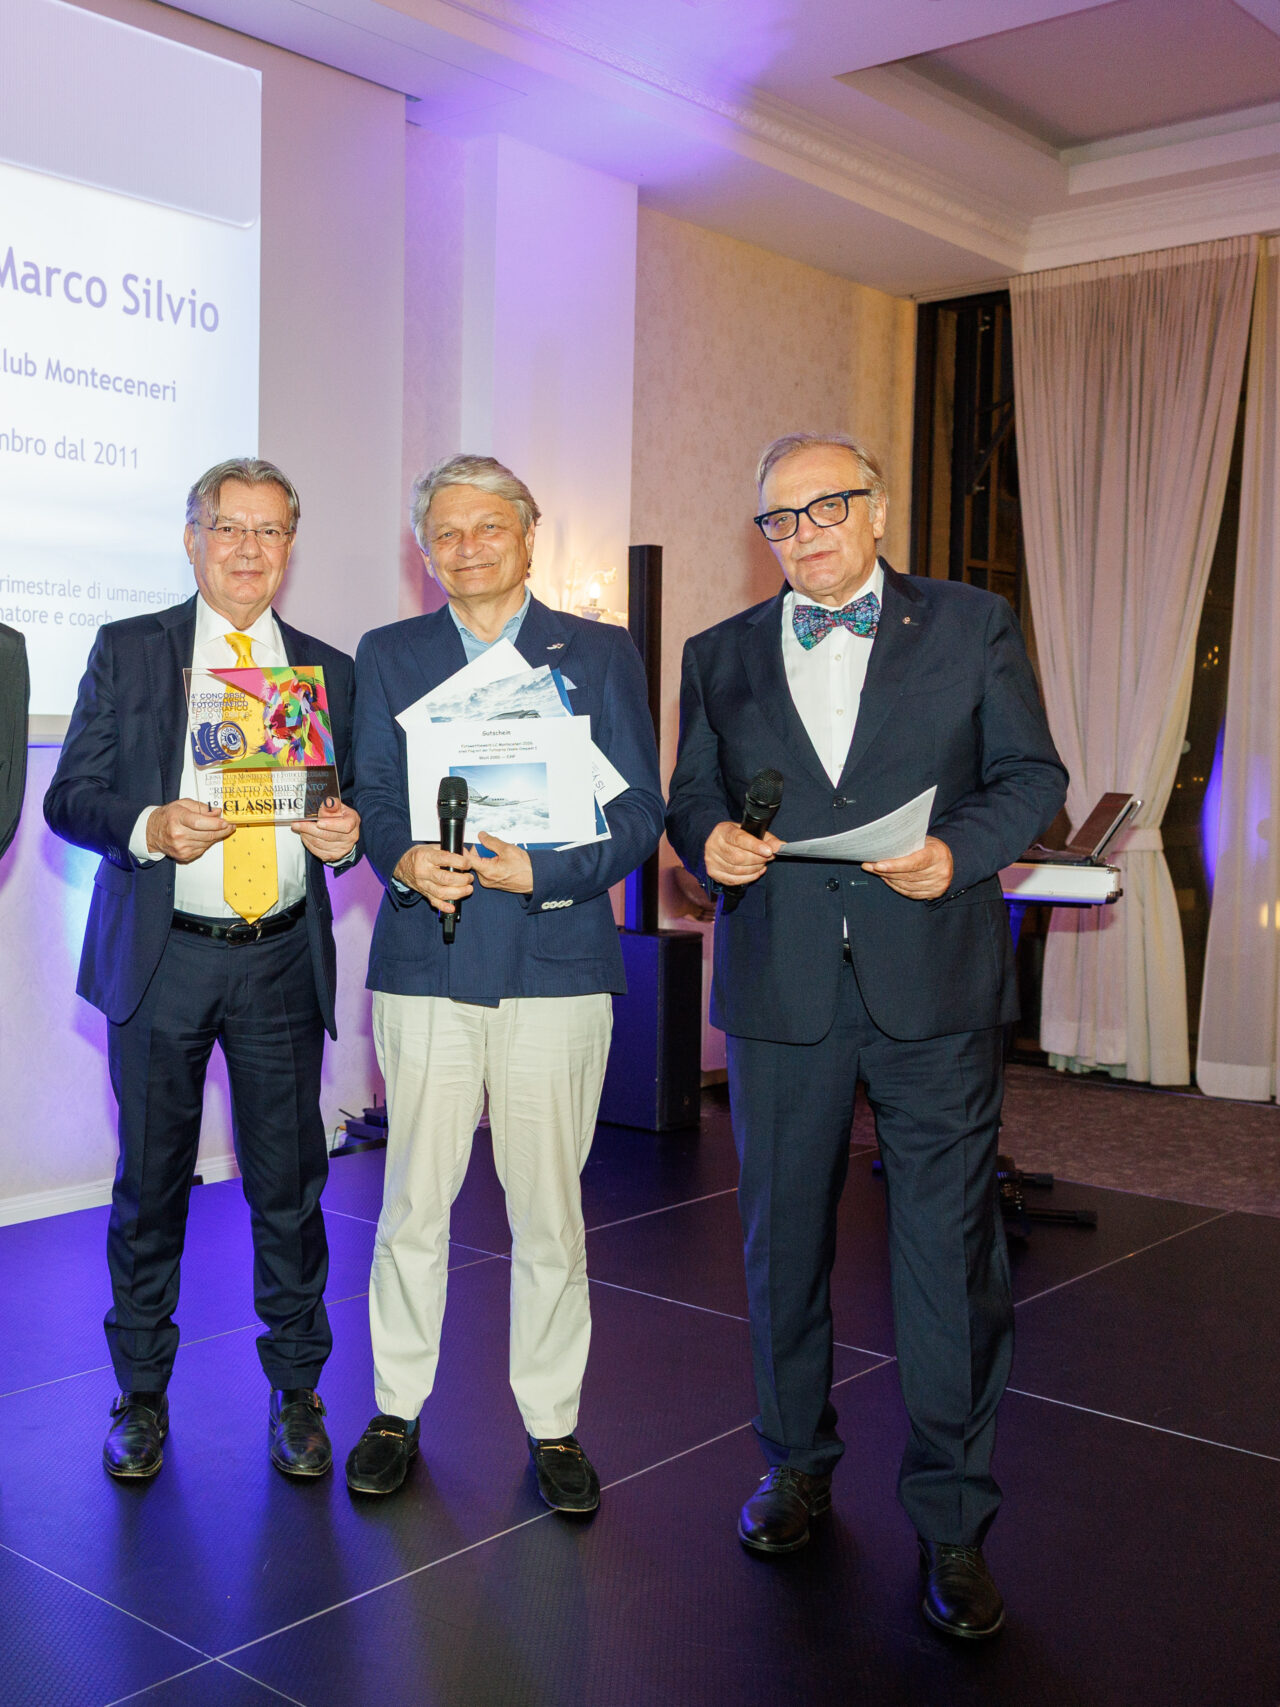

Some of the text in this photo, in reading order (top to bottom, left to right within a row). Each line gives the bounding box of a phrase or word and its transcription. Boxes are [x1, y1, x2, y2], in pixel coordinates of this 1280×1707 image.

[121, 272, 220, 333] Silvio
[45, 357, 177, 402] Monteceneri
[54, 435, 86, 463] dal
[93, 440, 139, 470] 2011
[87, 581, 102, 600] di
[54, 610, 64, 625] e
[69, 609, 113, 627] coach
